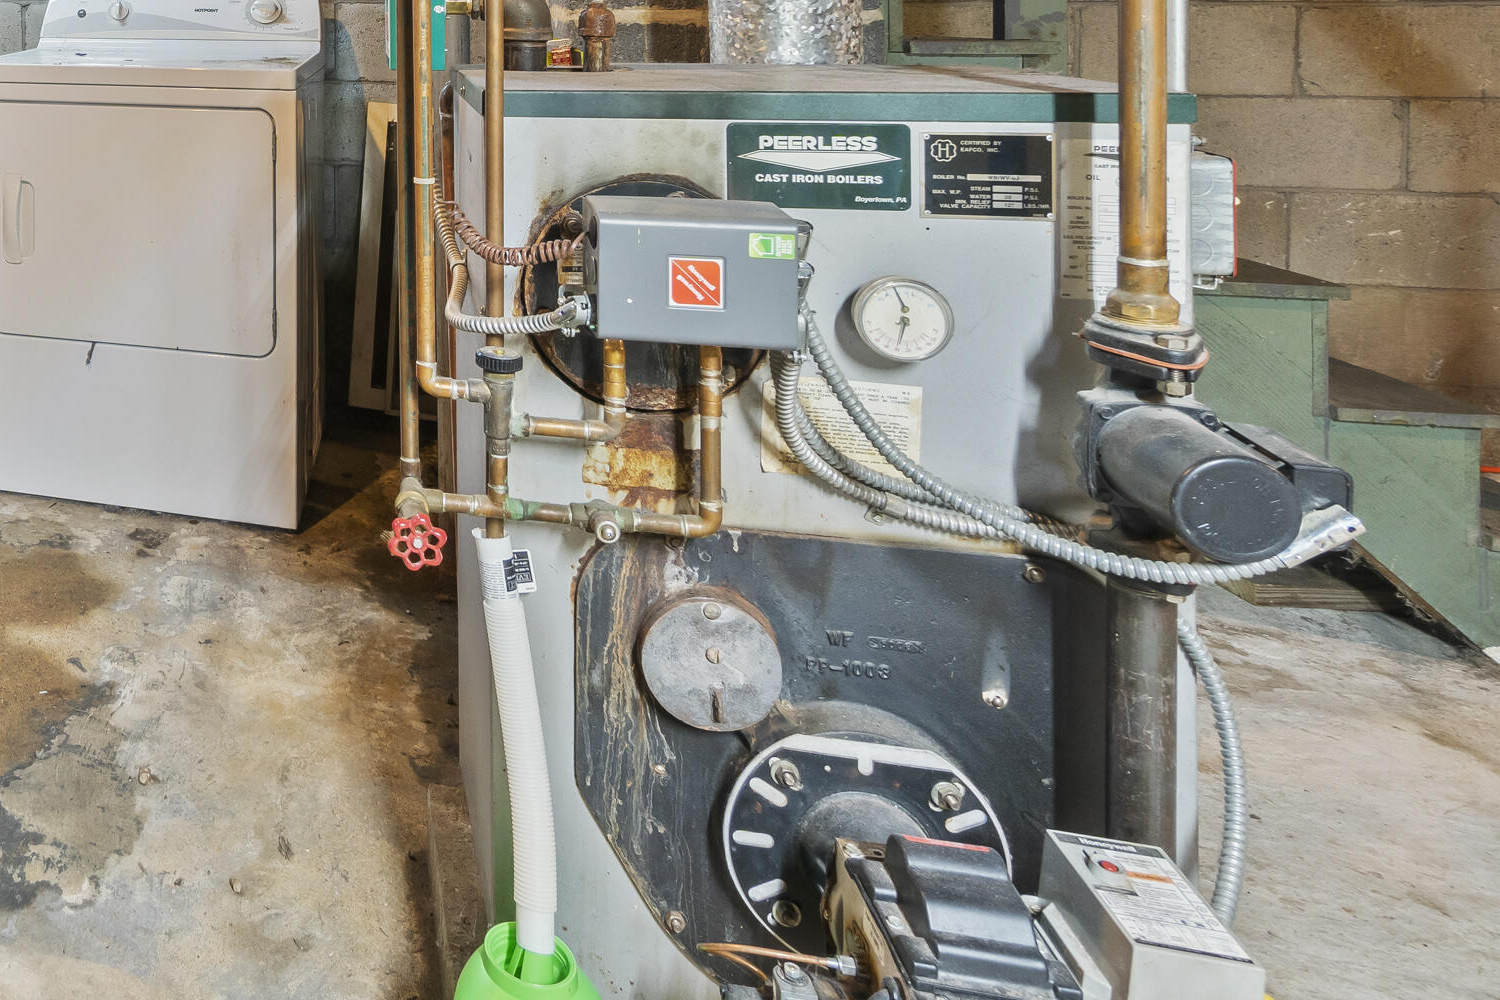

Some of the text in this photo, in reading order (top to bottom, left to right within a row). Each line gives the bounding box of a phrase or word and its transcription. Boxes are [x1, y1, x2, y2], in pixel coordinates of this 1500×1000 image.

[758, 135, 878, 151] PEERLESS
[755, 173, 884, 185] CAST IRON BOILERS
[825, 629, 854, 648] WF
[1077, 836, 1137, 853] Honeywell
